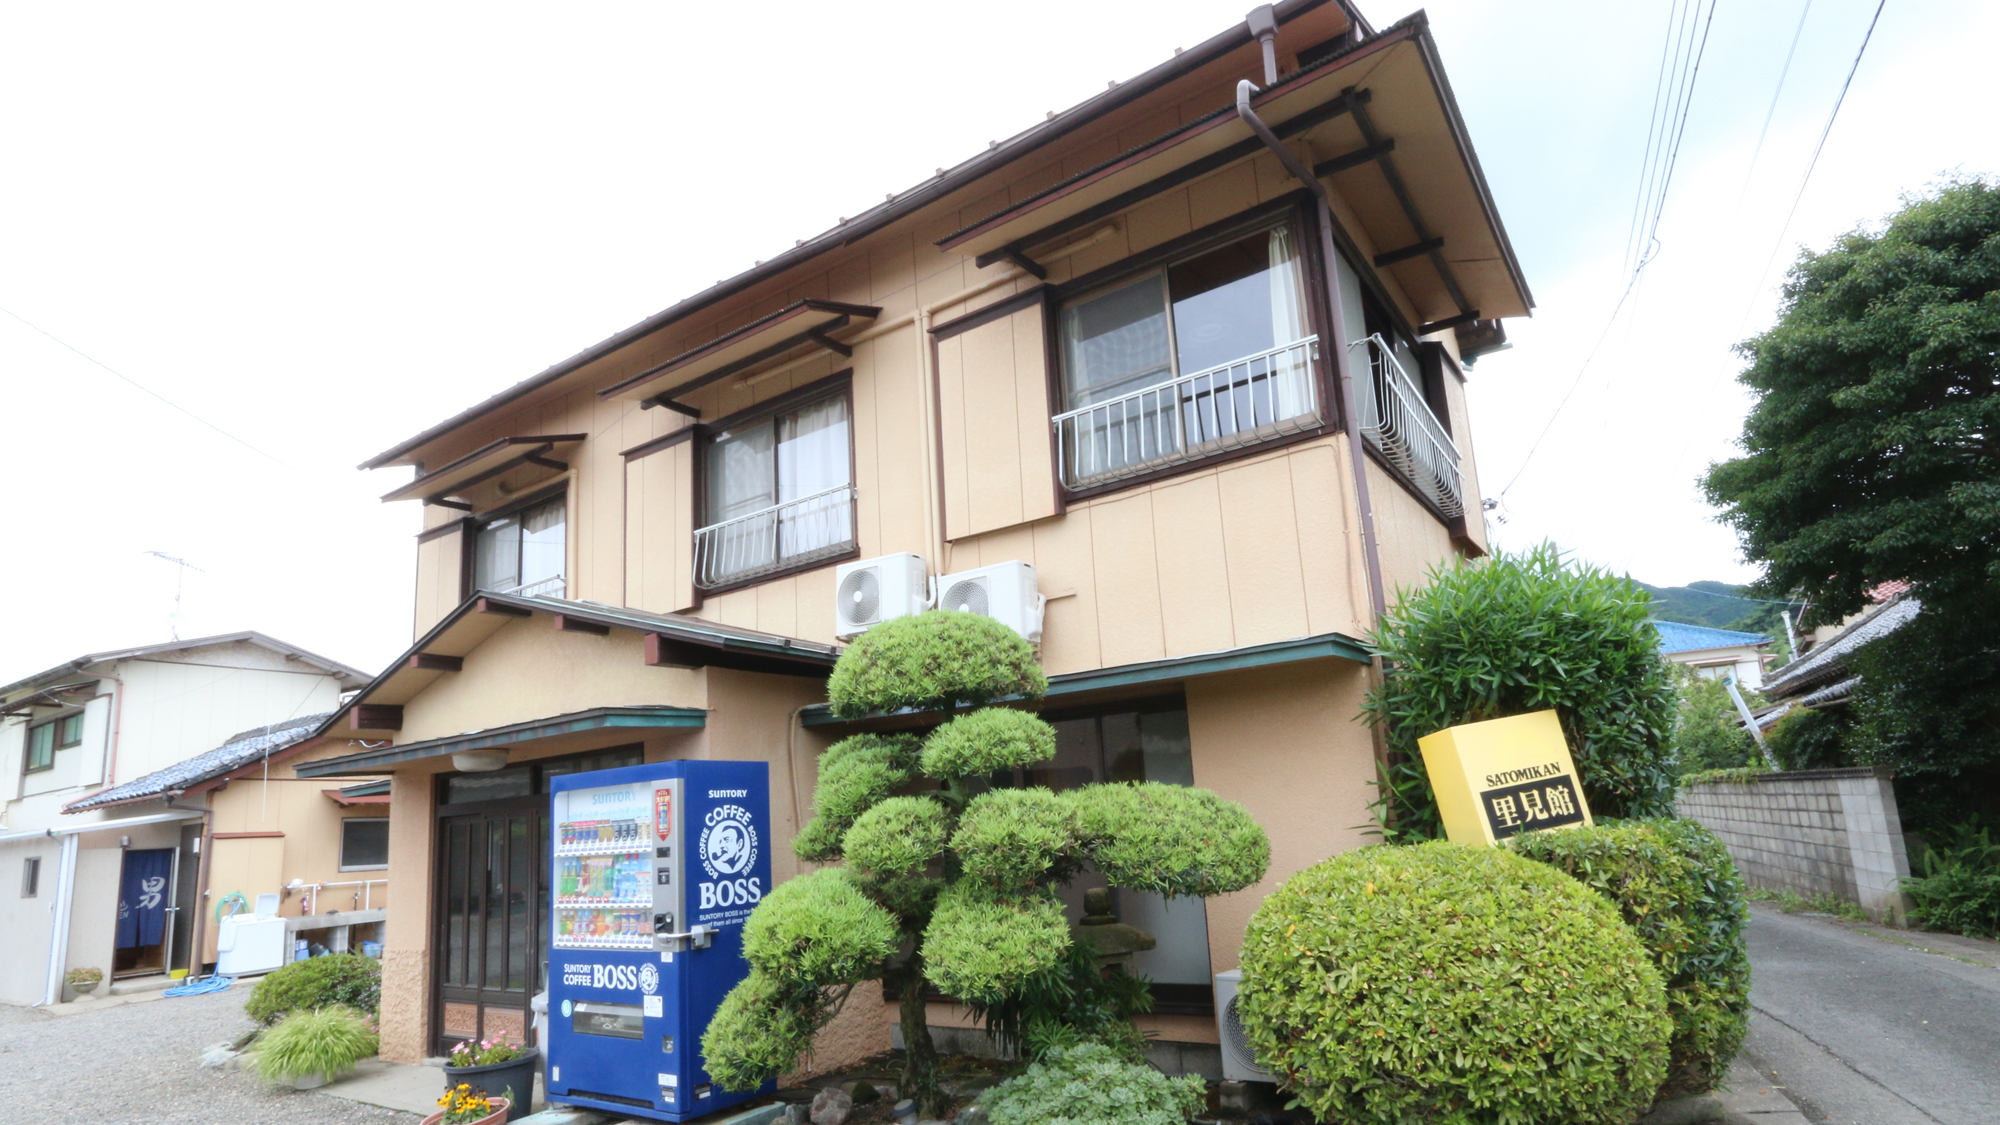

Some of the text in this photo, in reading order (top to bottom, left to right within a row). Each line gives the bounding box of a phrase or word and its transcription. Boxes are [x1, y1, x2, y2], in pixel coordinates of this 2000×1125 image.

[1486, 762, 1561, 787] SATOMIKAN
[592, 790, 637, 805] SUNTORY
[708, 789, 747, 798] SUNTORY
[705, 804, 752, 827] COFFEE
[1492, 785, 1575, 828] 里見館
[699, 827, 719, 879] BOSS COFFEE
[741, 825, 758, 876] BOSS COFFEE
[135, 876, 165, 910] 男
[699, 877, 761, 909] BOSS
[699, 912, 725, 921] SUNTORY
[724, 909, 739, 918] BOSS
[563, 974, 591, 986] COFFEE
[564, 963, 591, 973] SUNTORY
[593, 964, 637, 990] BOSS
